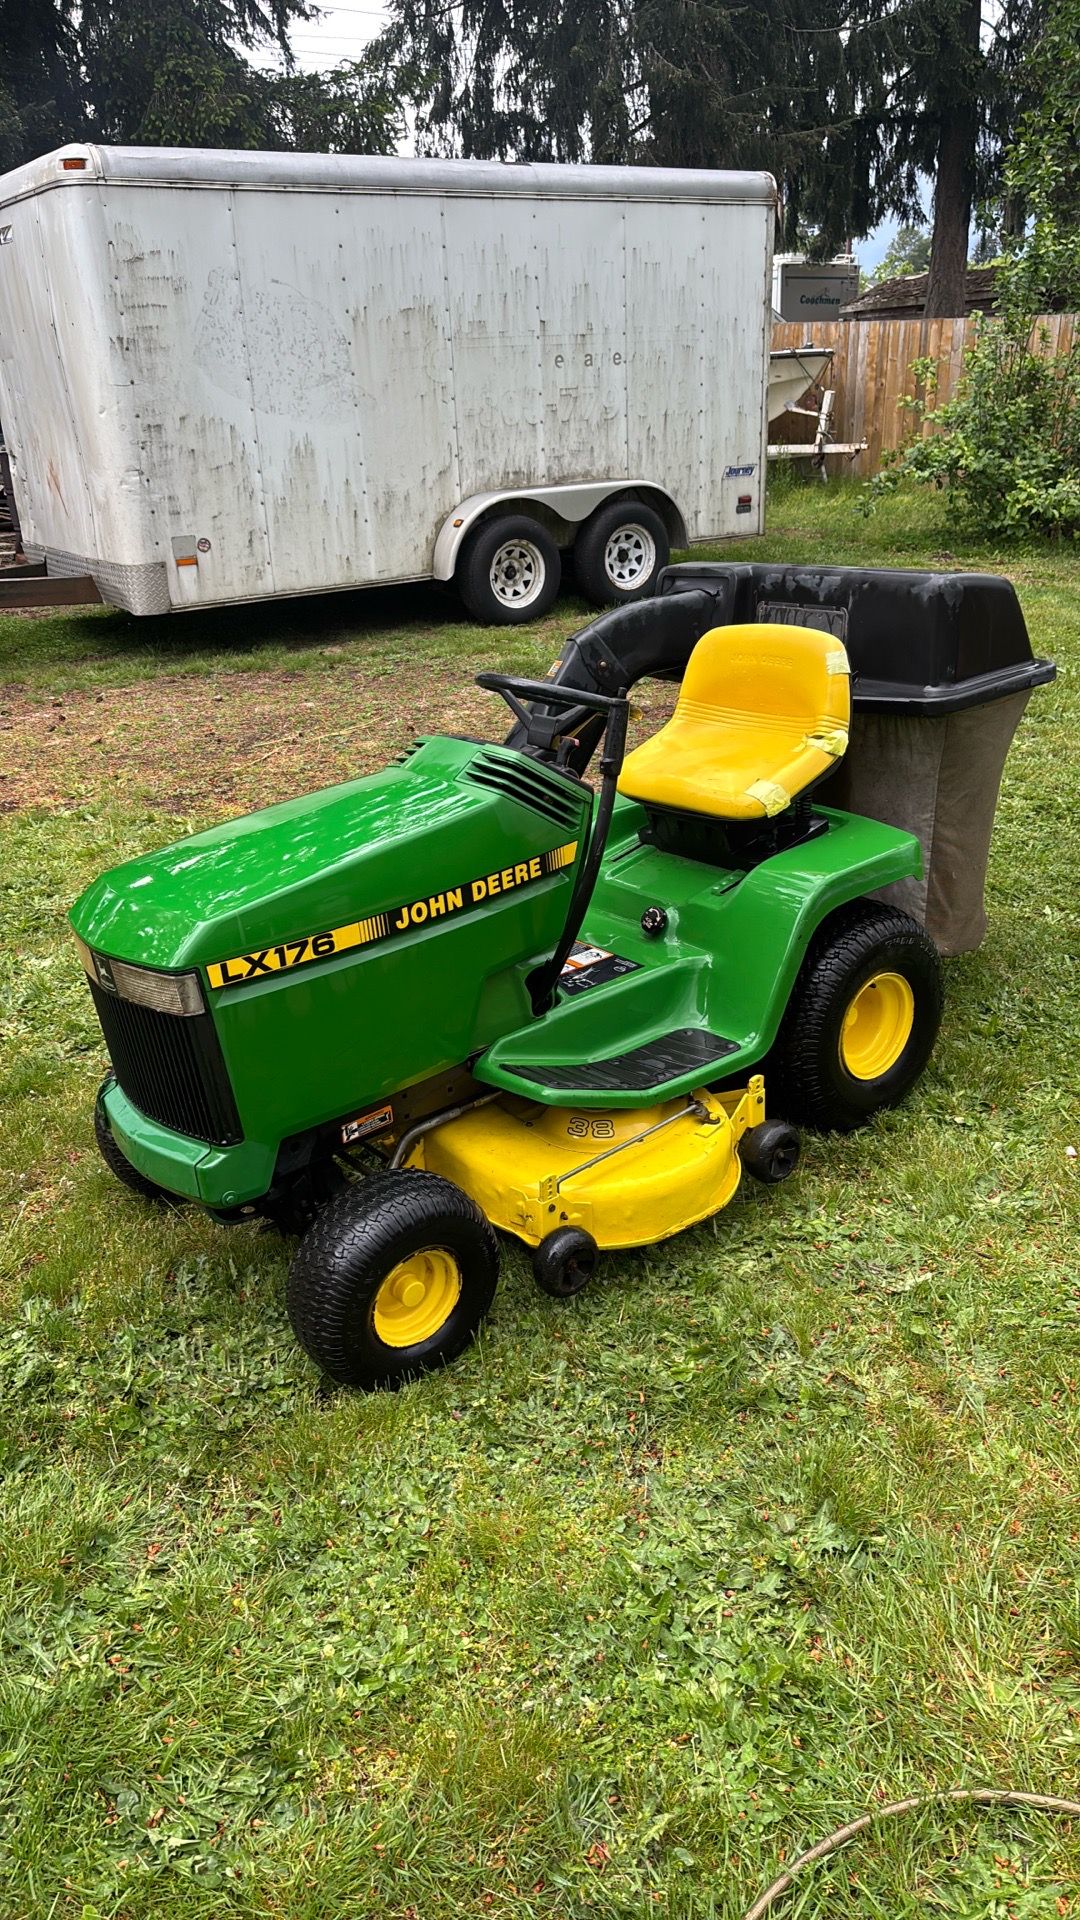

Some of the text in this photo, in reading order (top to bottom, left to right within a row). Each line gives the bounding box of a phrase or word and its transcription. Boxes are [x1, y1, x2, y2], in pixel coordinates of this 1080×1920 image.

[800, 294, 841, 305] Coachmen
[395, 857, 542, 930] JOHN DEERE
[219, 932, 336, 985] LX176
[567, 1116, 615, 1139] 38
